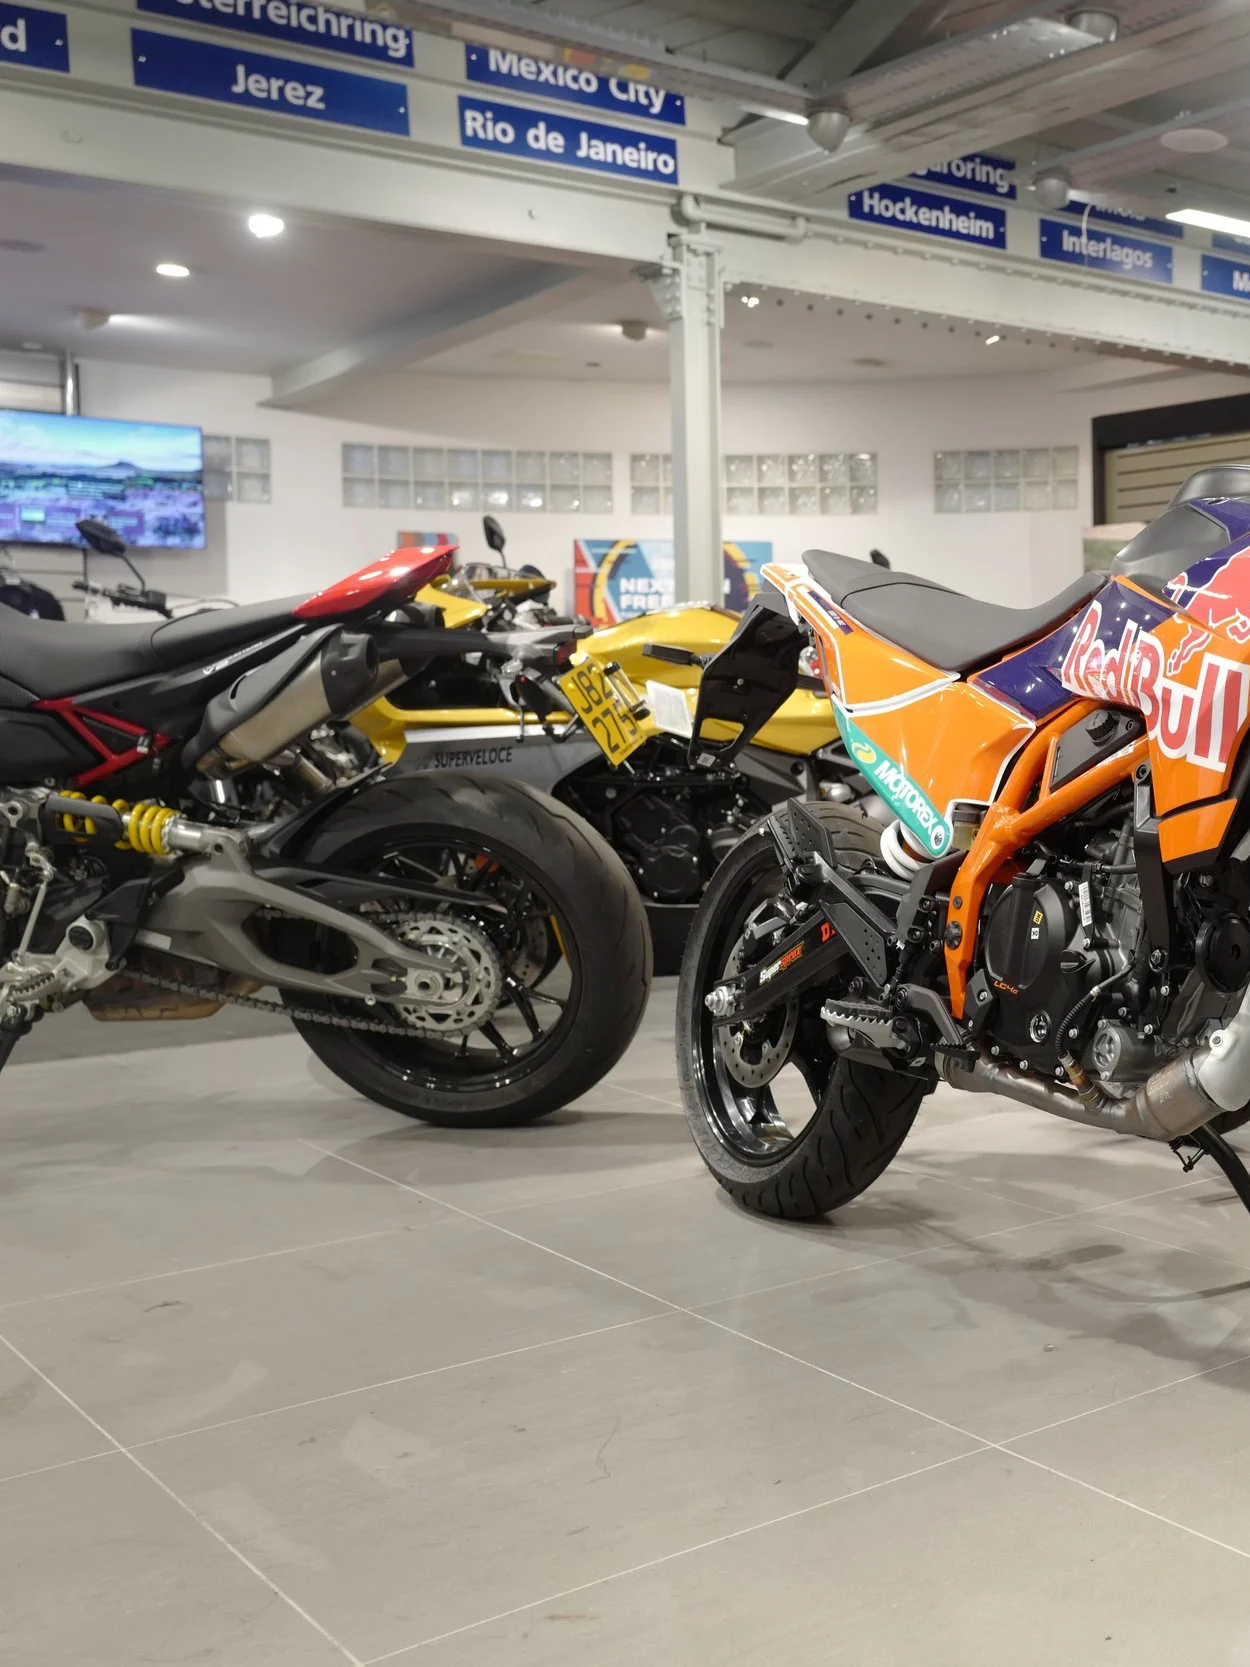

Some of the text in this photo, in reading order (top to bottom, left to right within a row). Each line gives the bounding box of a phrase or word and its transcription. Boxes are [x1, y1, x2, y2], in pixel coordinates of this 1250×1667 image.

[231, 64, 326, 110] Jerez
[488, 48, 666, 114] Mexico City
[464, 109, 675, 175] Rio de Janeiro
[862, 190, 994, 239] Hockenheim
[1062, 230, 1153, 270] Interlagos
[1062, 600, 1250, 772] Red Bull
[434, 746, 513, 768] SUPERVELOCE
[874, 760, 939, 835] MOTOREX
